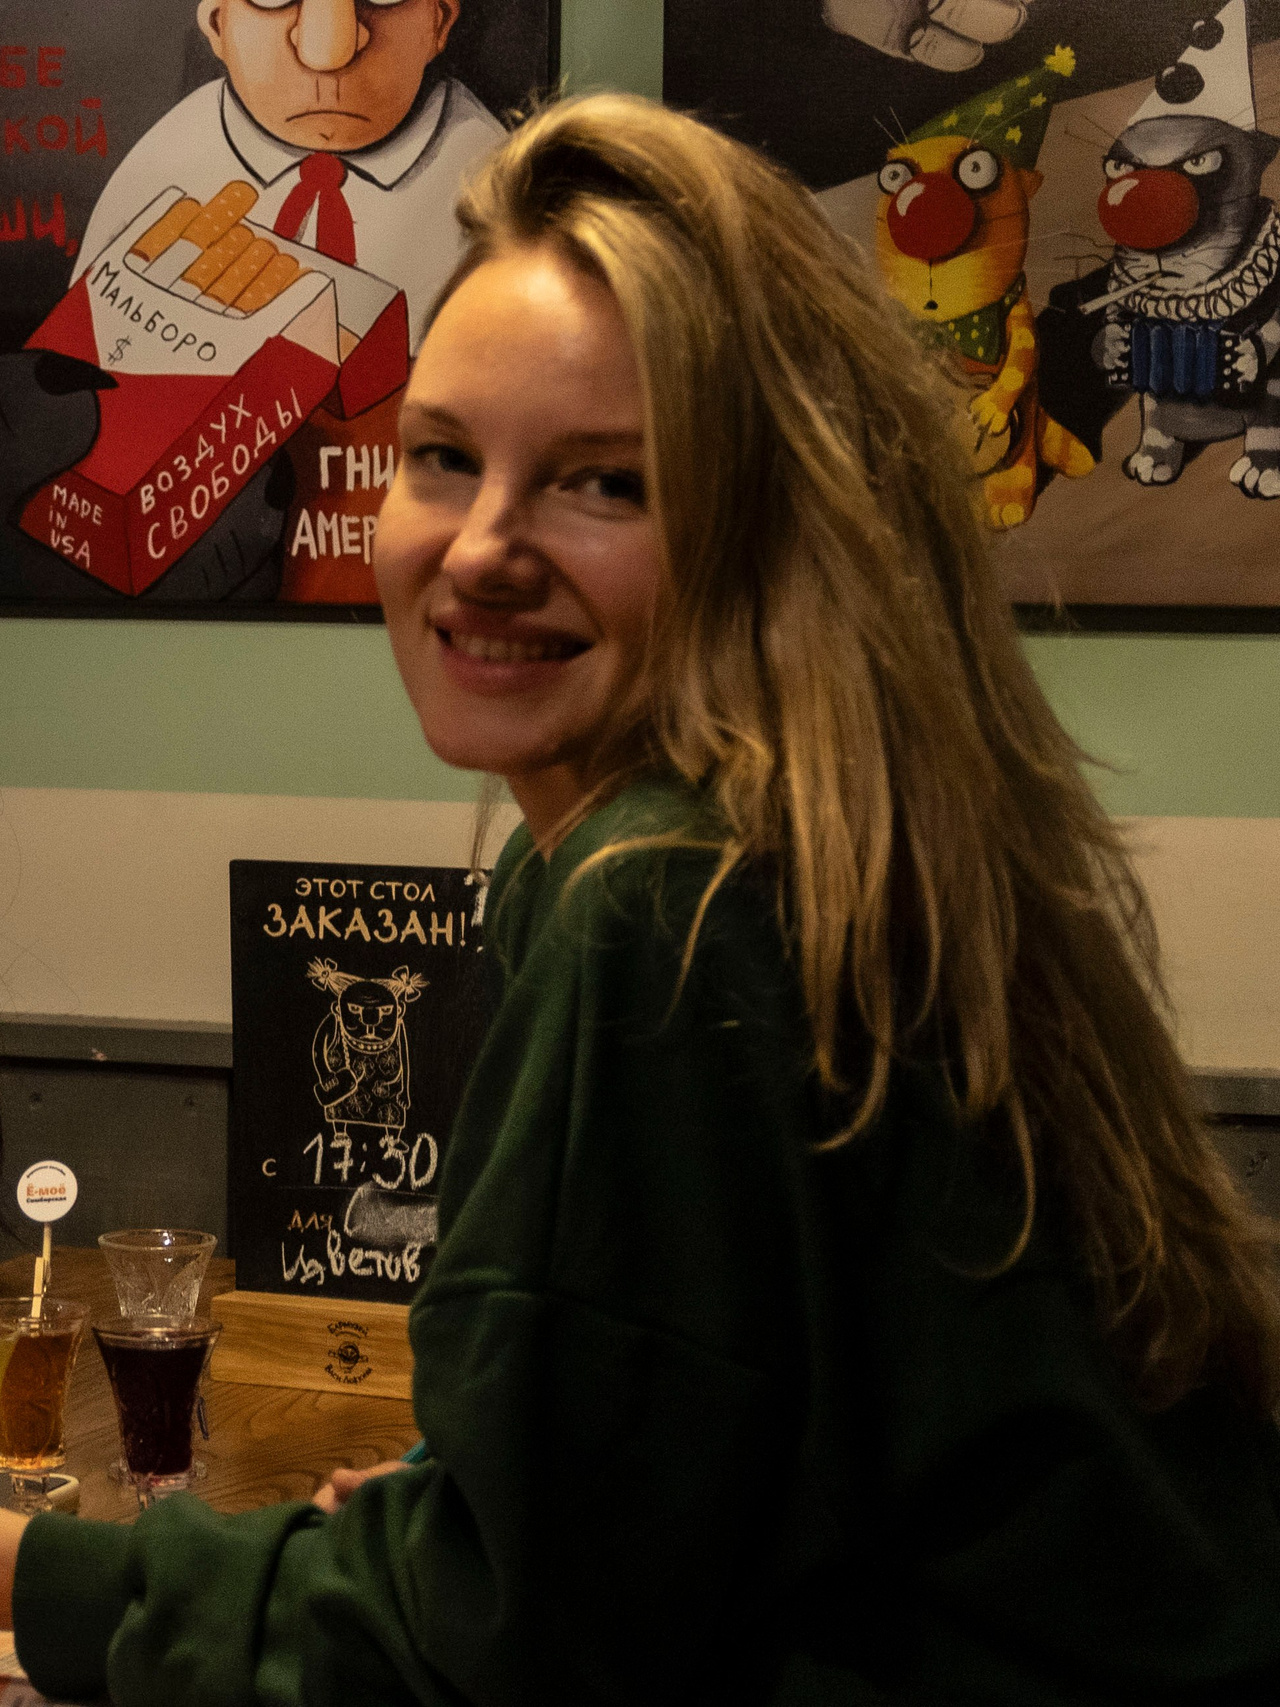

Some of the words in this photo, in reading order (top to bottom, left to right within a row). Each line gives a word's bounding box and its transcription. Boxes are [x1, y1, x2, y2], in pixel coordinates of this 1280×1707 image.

[90, 260, 218, 363] МАЛЬБОРО
[140, 393, 253, 516] ВОЗДУХ
[147, 386, 303, 560] СВОБОДЫ
[52, 484, 103, 526] MADE
[50, 528, 91, 570] USA
[295, 877, 364, 899] ЭТОТ
[370, 881, 436, 902] СТОЛ
[263, 903, 466, 947] ЗАКАЗАН!
[303, 1132, 438, 1190] 17:30
